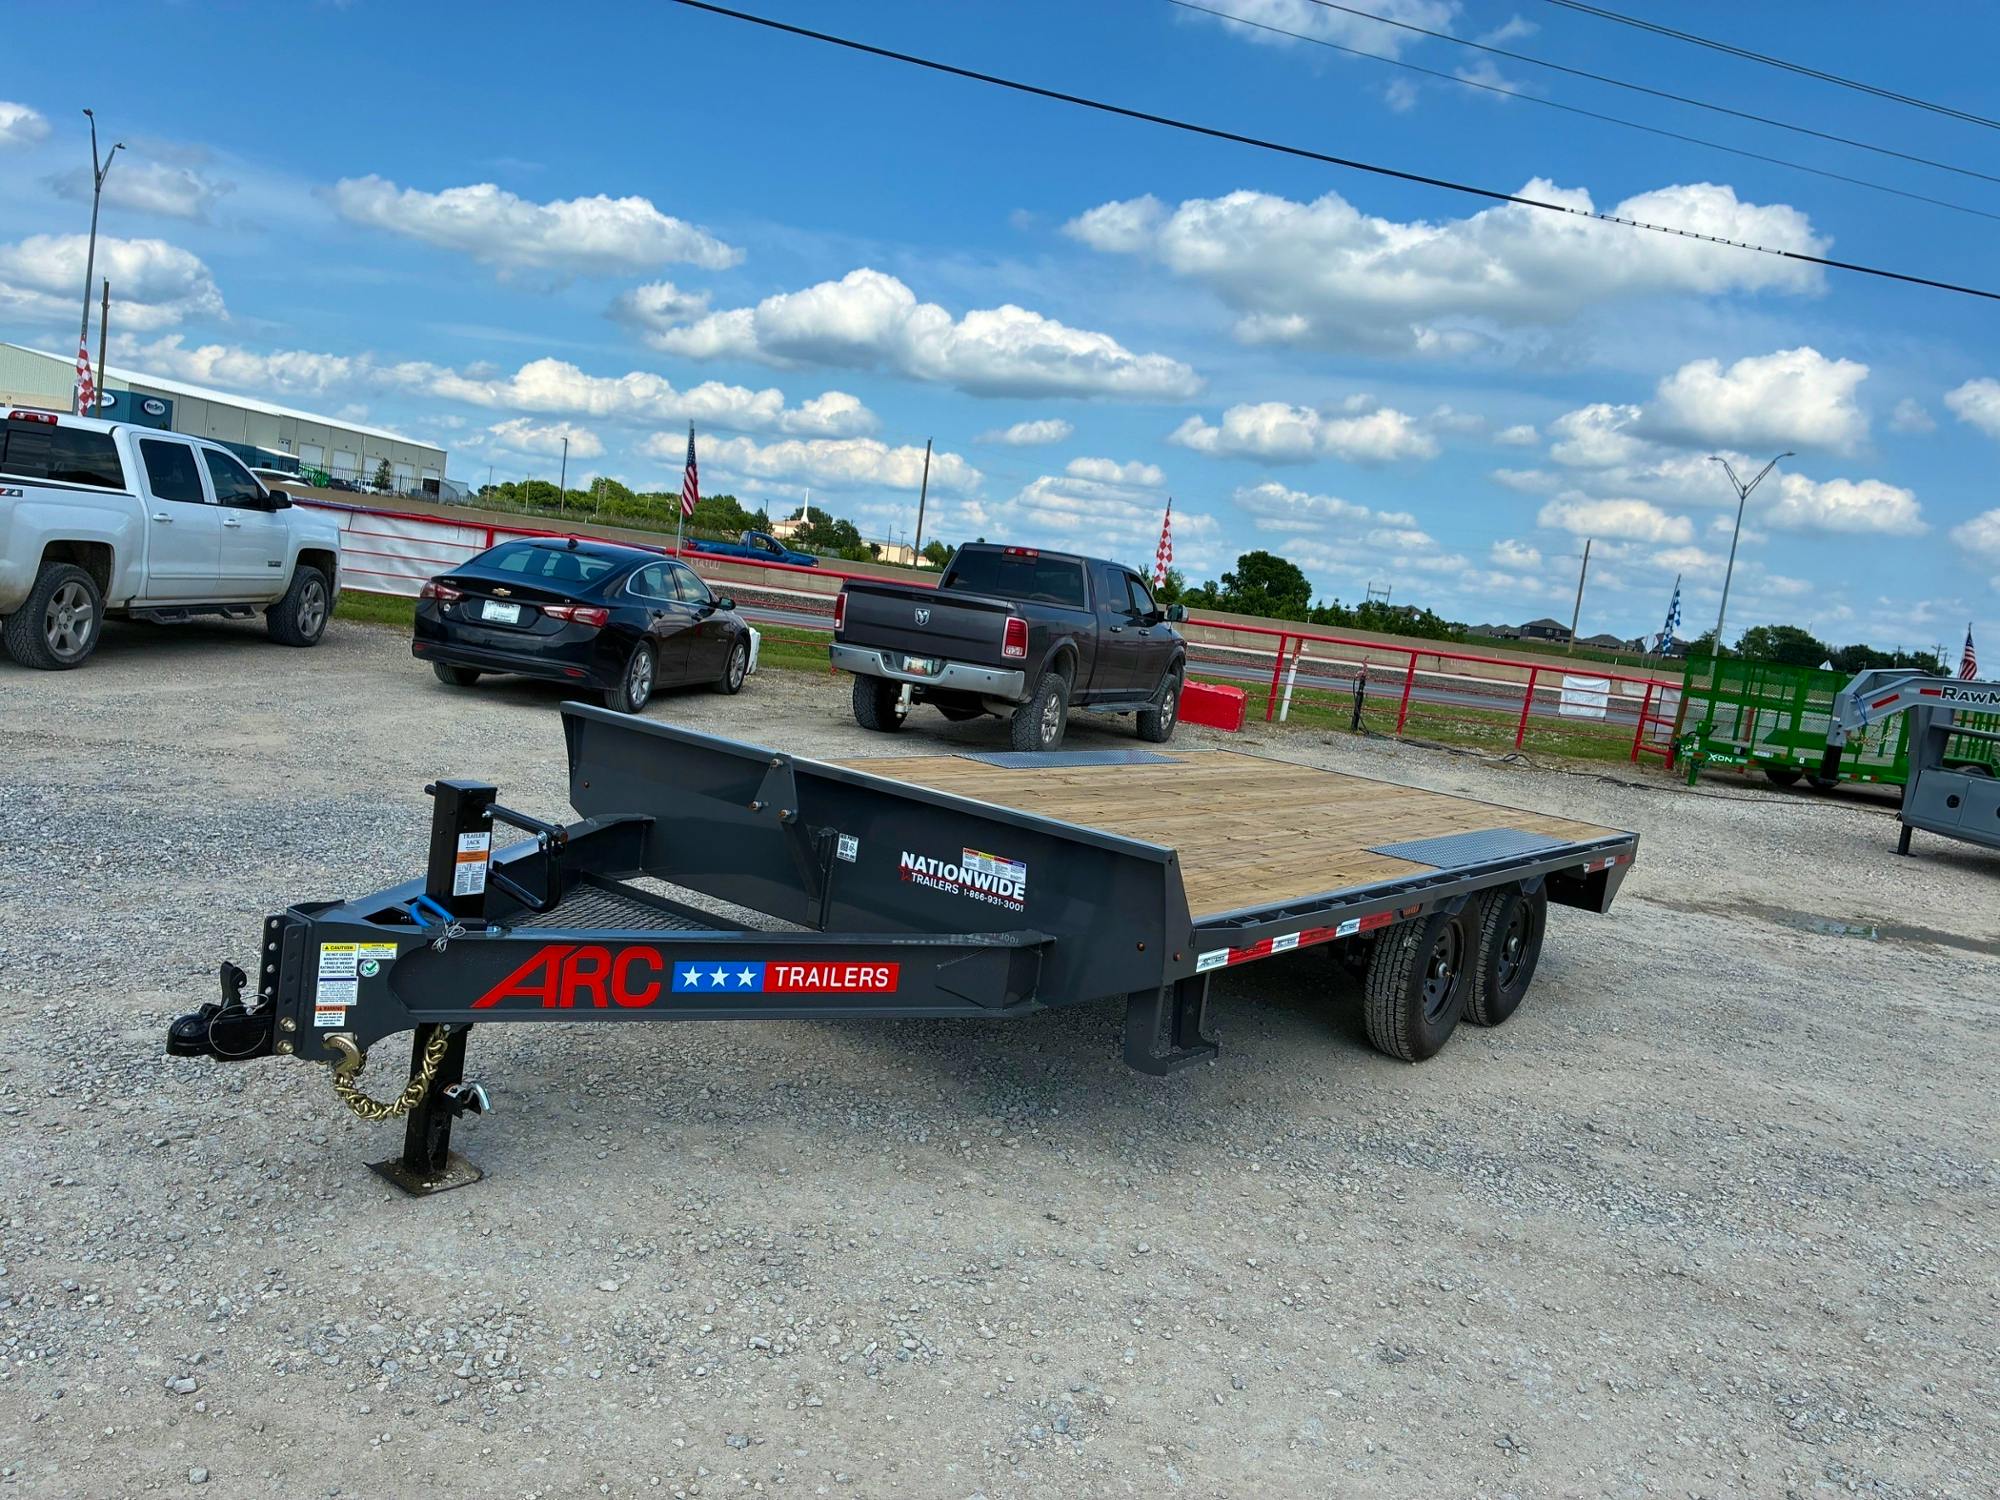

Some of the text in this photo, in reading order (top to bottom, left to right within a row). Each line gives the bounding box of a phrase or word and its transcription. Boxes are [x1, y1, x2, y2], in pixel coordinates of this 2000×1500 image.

[901, 851, 1026, 901] NATIONWIDE
[911, 872, 1024, 912] TRAILERS 1-866-931-3001
[470, 944, 890, 1009] ARC TRAILERS
